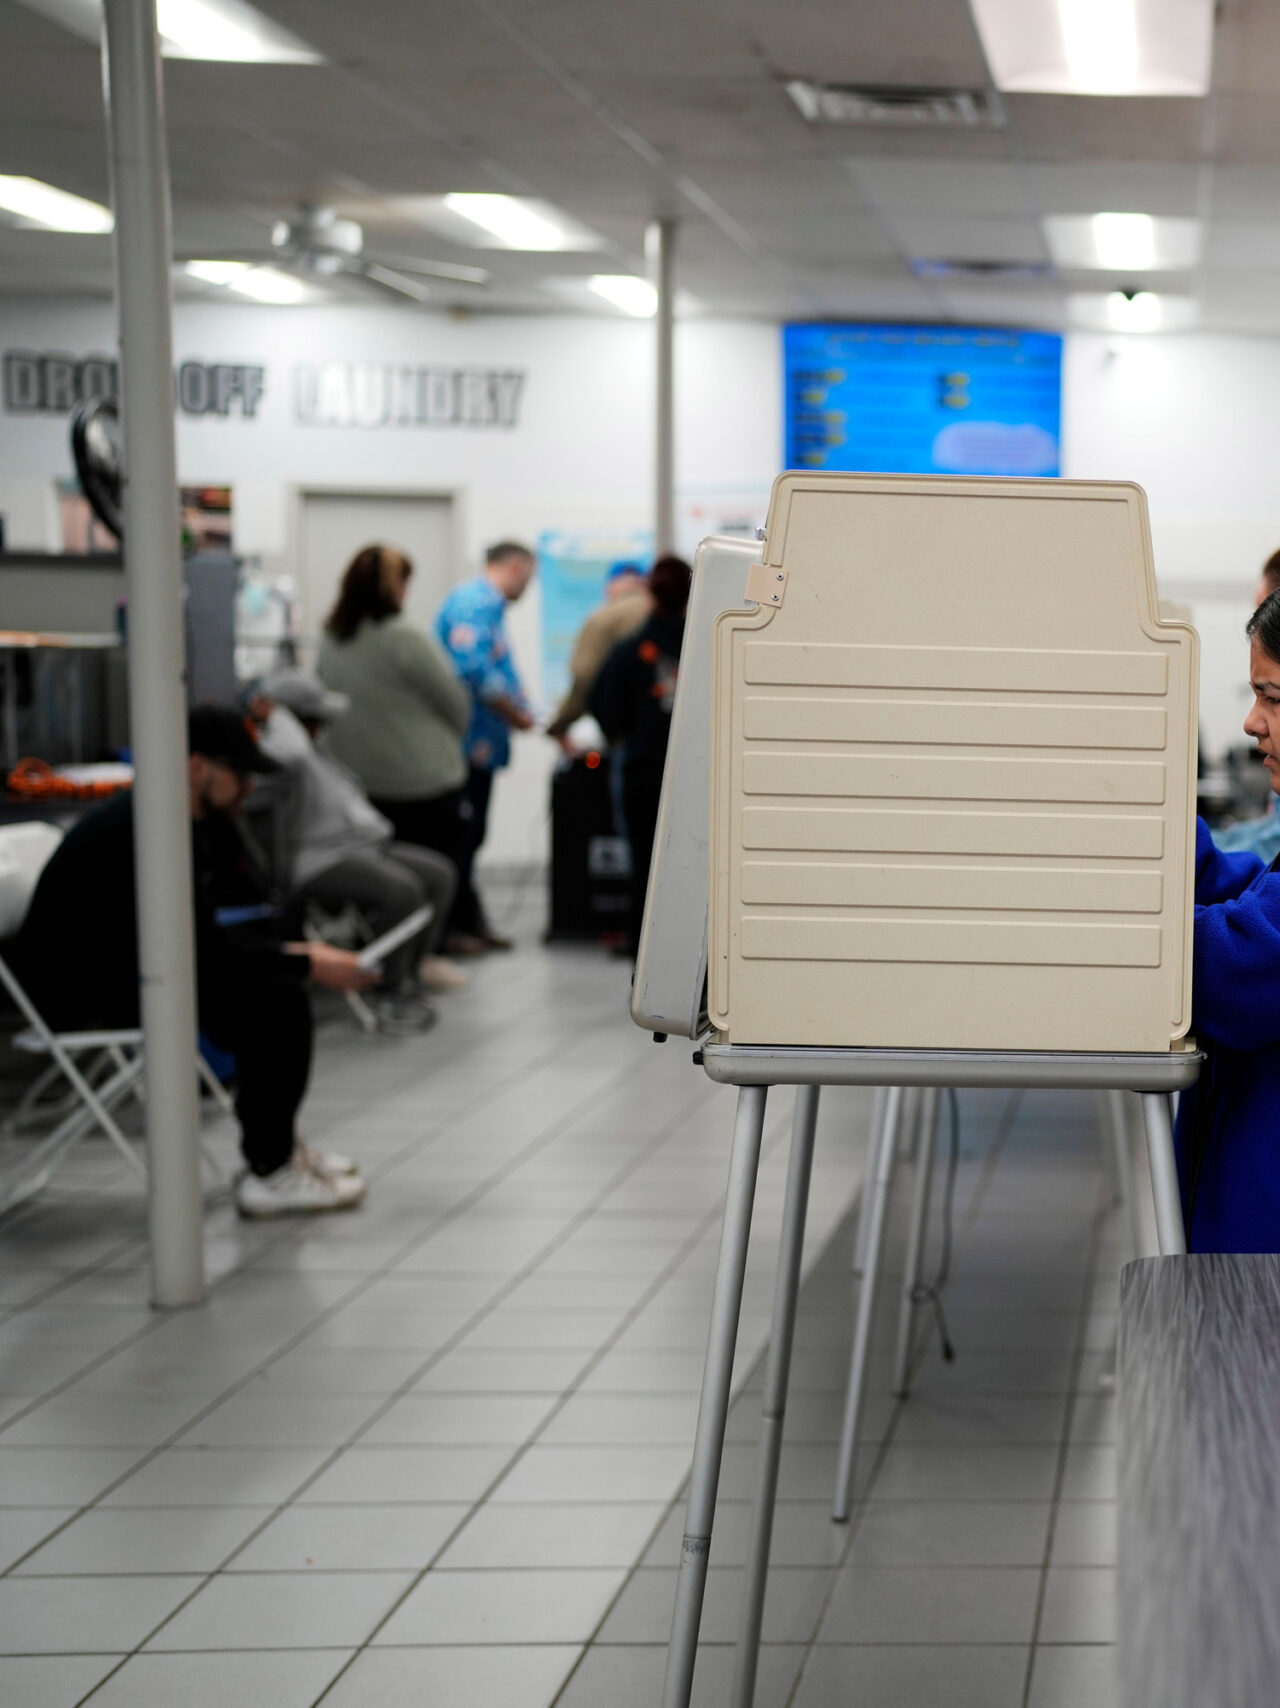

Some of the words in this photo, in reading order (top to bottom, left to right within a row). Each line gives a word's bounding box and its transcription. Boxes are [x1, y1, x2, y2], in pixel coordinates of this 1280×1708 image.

[5, 350, 121, 414] DRO
[179, 362, 265, 419] OFF
[294, 361, 527, 430] LAUNDRY
